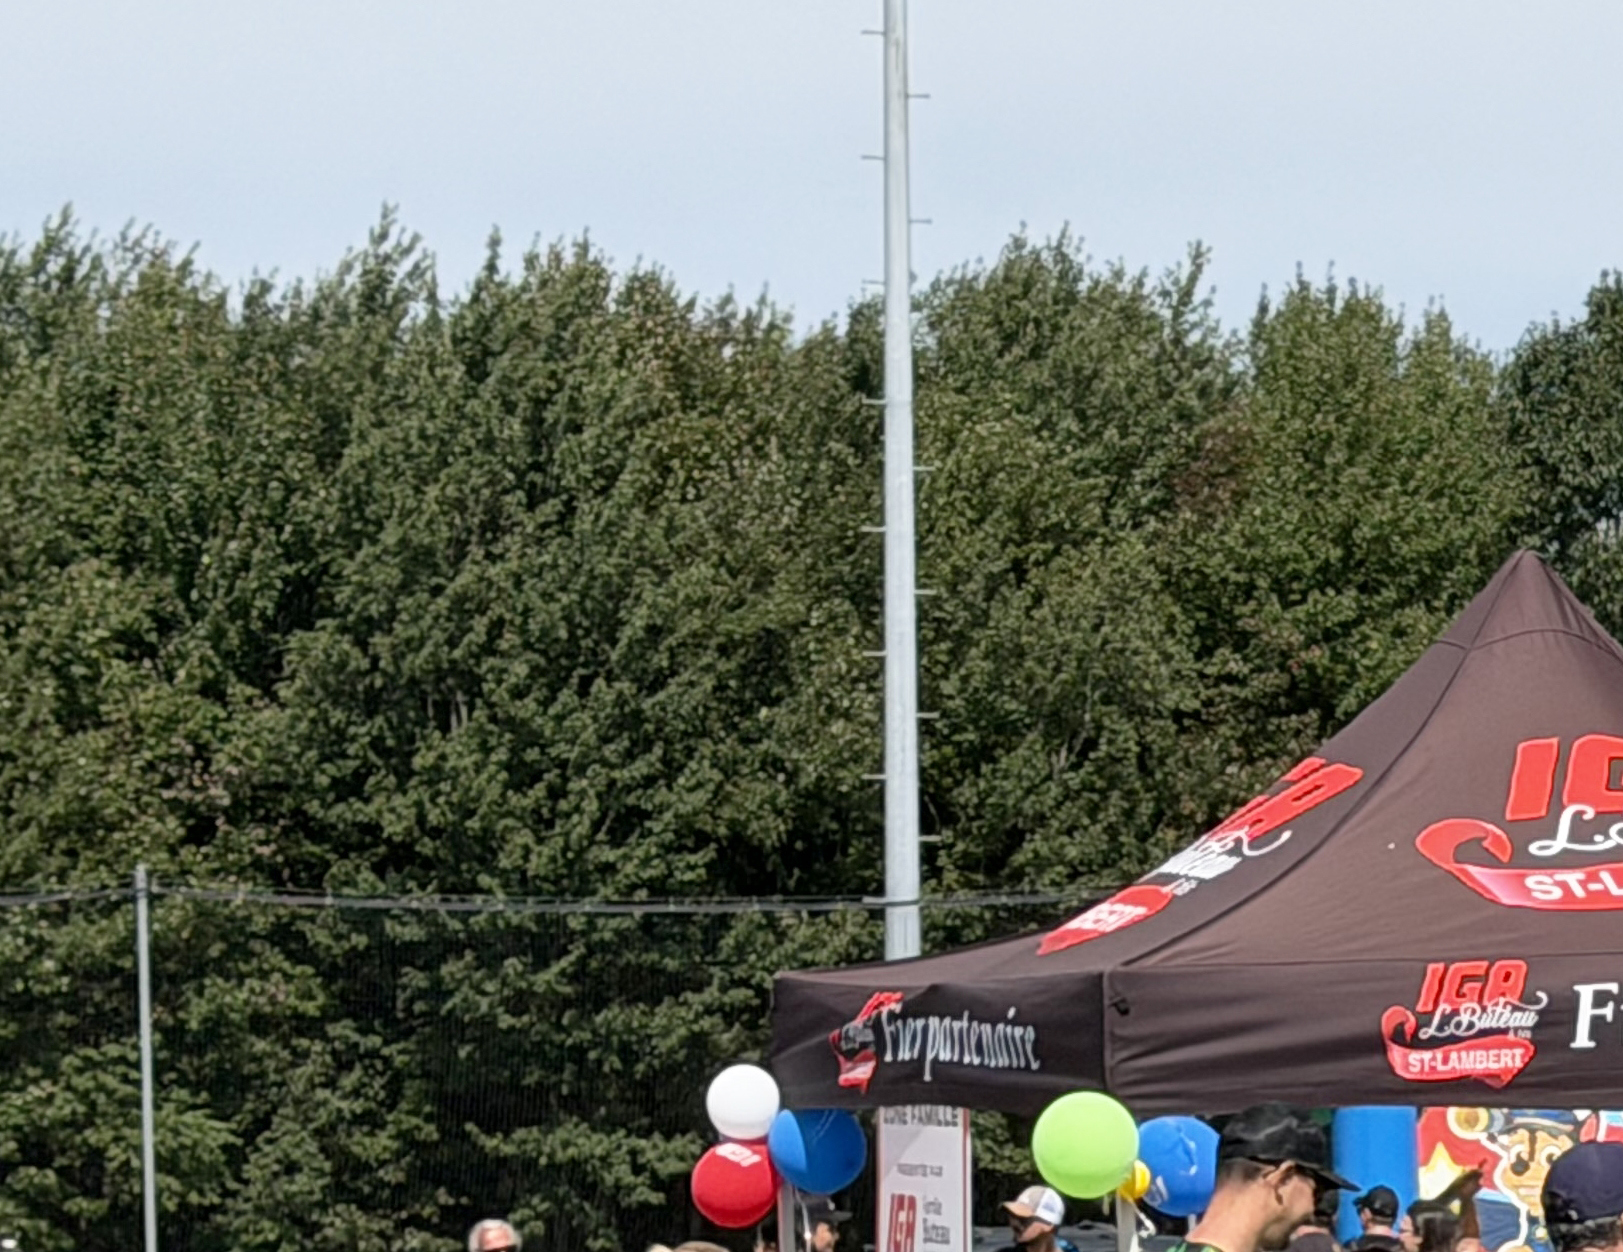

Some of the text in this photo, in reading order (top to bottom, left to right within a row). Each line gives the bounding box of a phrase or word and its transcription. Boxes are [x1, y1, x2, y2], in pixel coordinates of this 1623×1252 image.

[1416, 960, 1527, 1012] IGA
[881, 1003, 925, 1063] Fier
[924, 1005, 1041, 1082] partenaire
[1408, 1048, 1526, 1073] ST-LAMBERT
